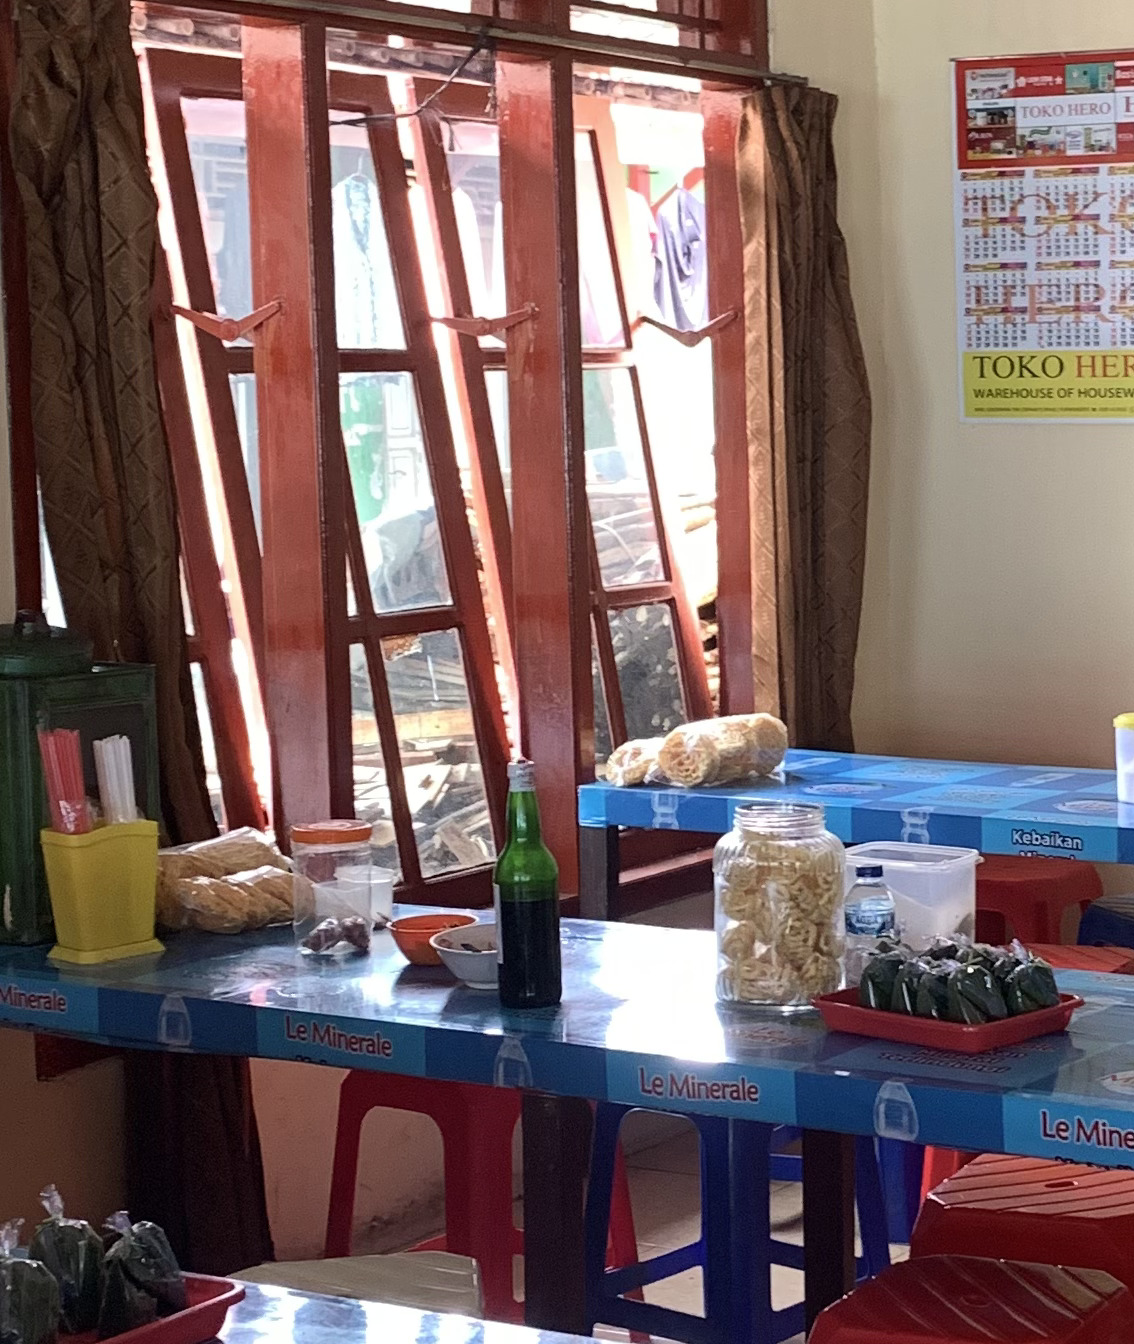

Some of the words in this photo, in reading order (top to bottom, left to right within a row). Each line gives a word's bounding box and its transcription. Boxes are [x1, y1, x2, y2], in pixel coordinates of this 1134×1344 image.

[1021, 104, 1064, 119] TOKO
[1068, 102, 1112, 117] HERO
[973, 354, 1065, 379] TOKO
[973, 387, 1054, 399] WAREHOUSE
[1057, 387, 1074, 398] OF
[1012, 829, 1083, 851] Kebaikan
[0, 984, 68, 1013] Minerale
[285, 1015, 308, 1041] Le
[312, 1021, 393, 1057] Minerale
[639, 1067, 664, 1096] Le
[669, 1073, 759, 1102] Minerale
[1041, 1109, 1070, 1141] Le
